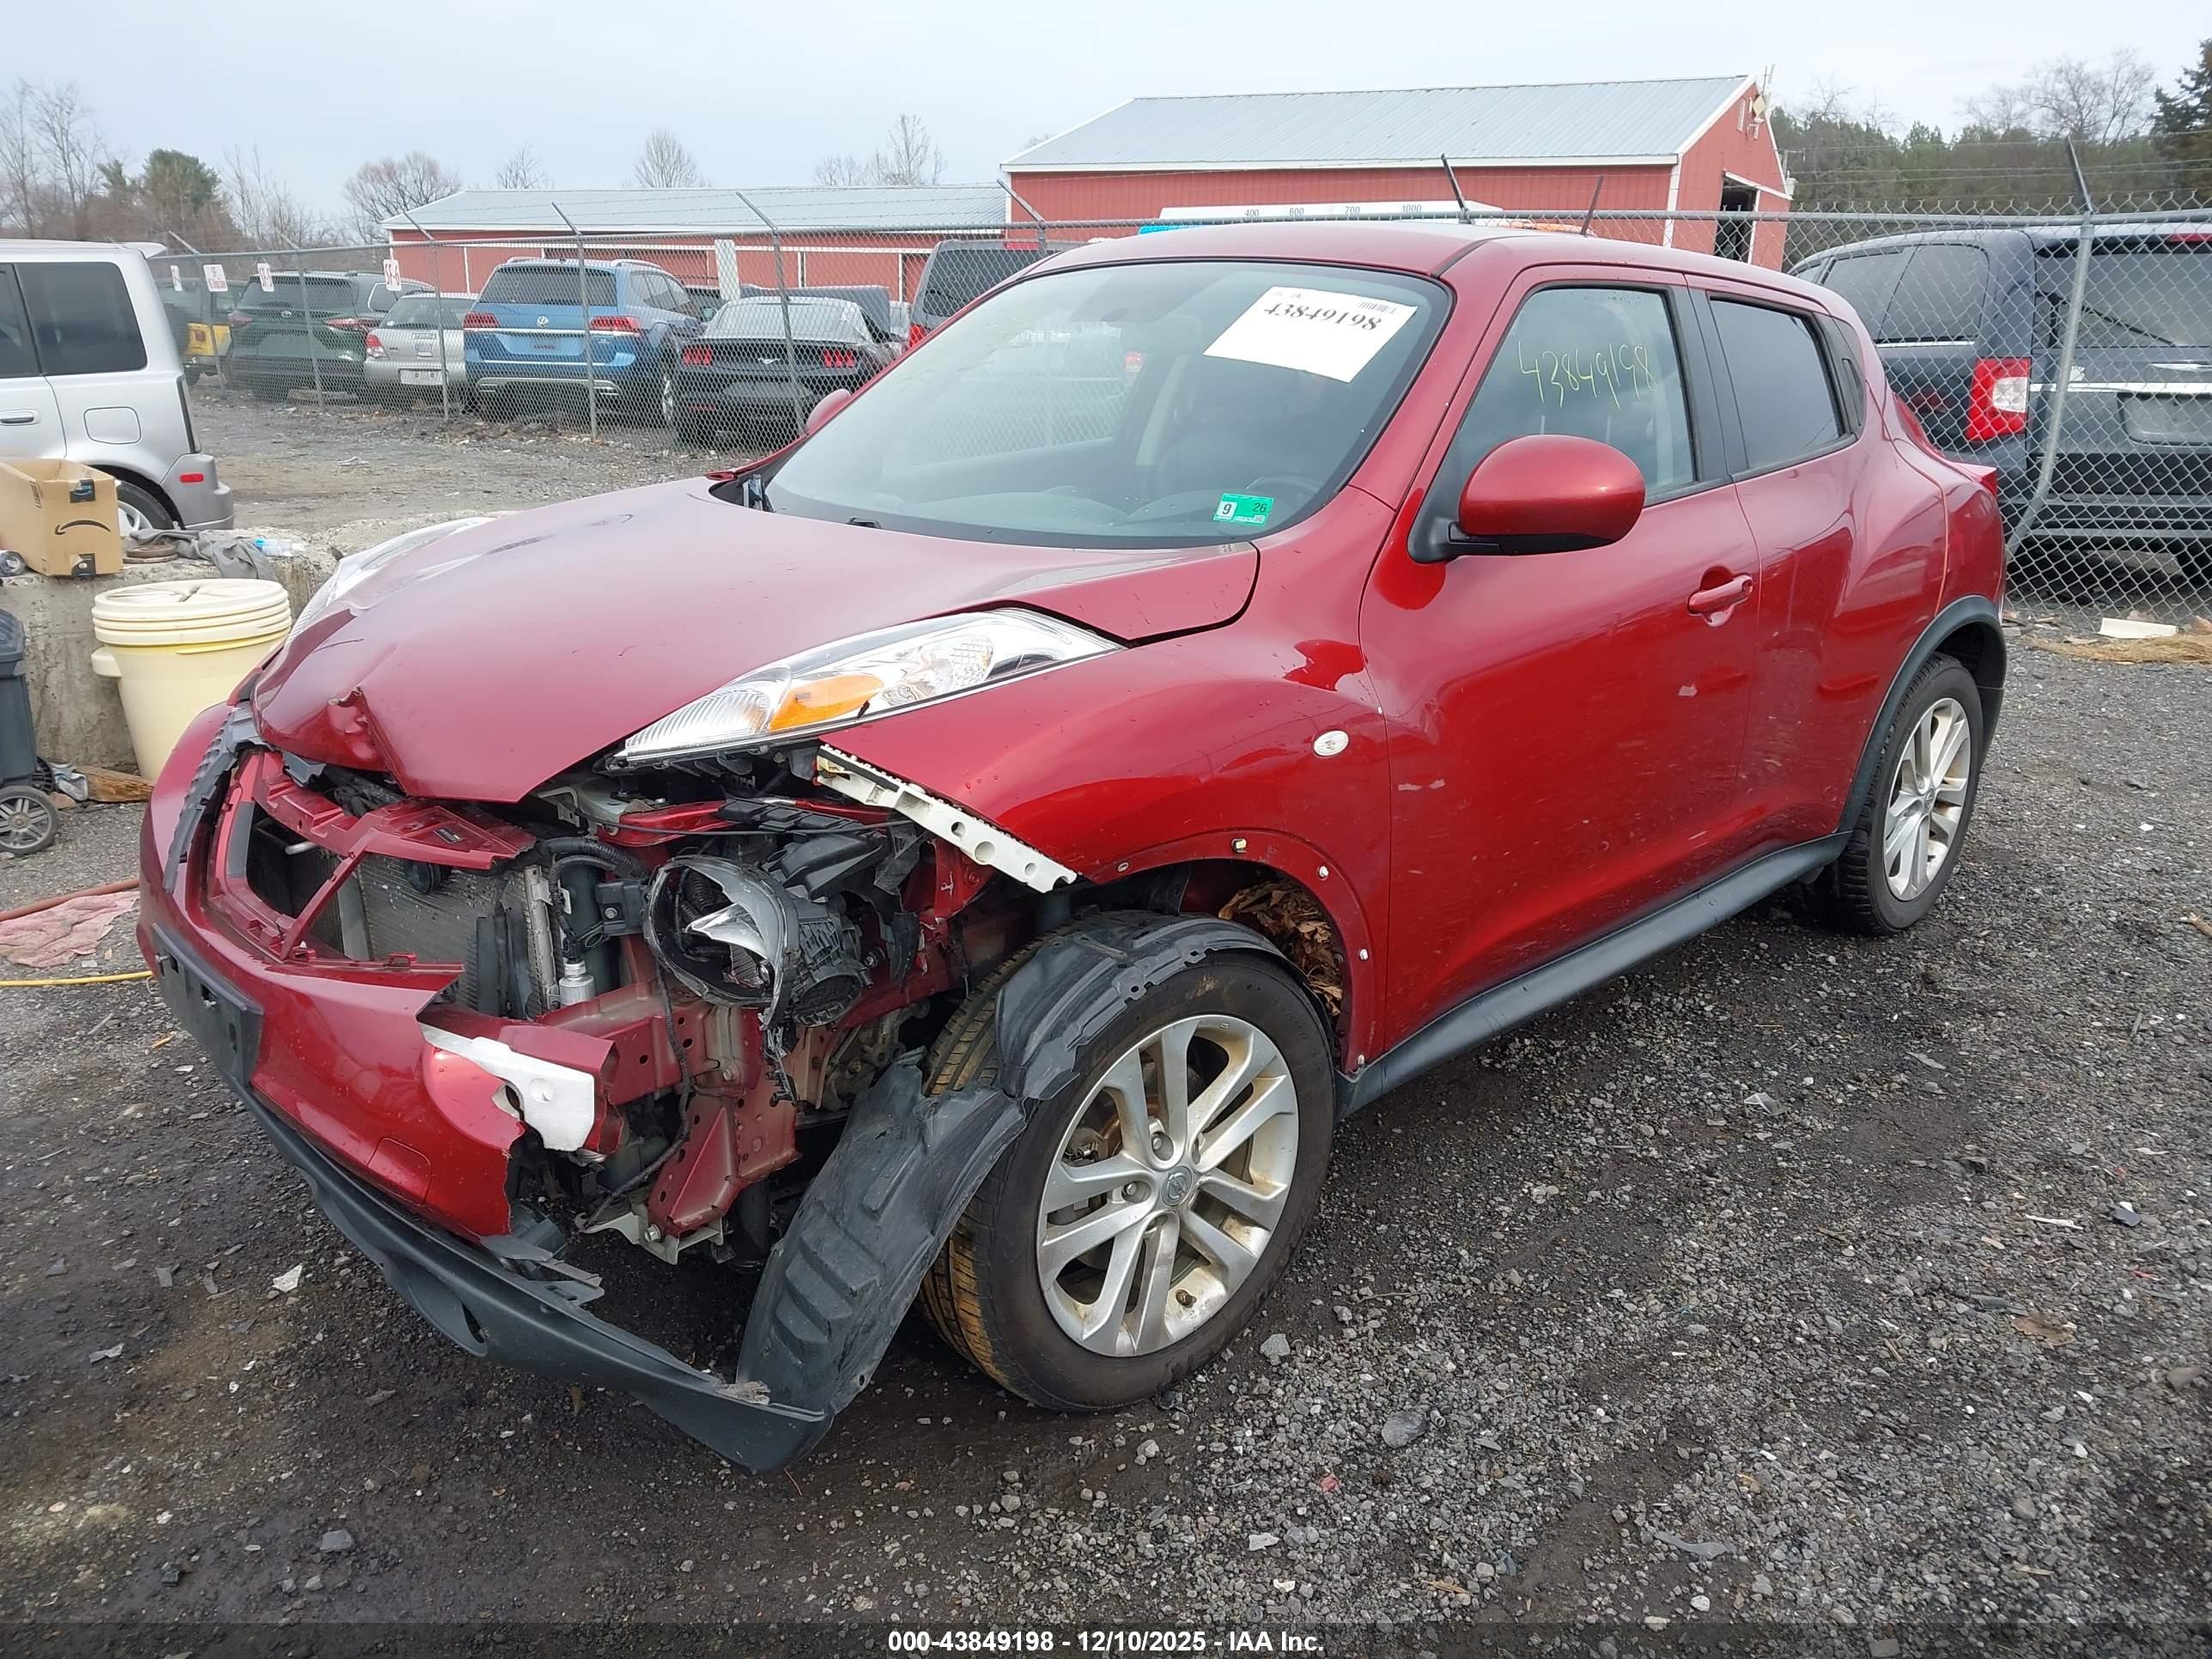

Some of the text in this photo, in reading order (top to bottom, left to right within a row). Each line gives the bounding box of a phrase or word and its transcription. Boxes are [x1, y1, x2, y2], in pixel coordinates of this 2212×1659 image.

[1244, 209, 1260, 217] 400
[1289, 207, 1304, 216] 600
[1402, 204, 1422, 213] 1000
[1264, 302, 1382, 331] 43849198
[1518, 340, 1656, 410] 43849198
[1222, 502, 1267, 515] 9 26
